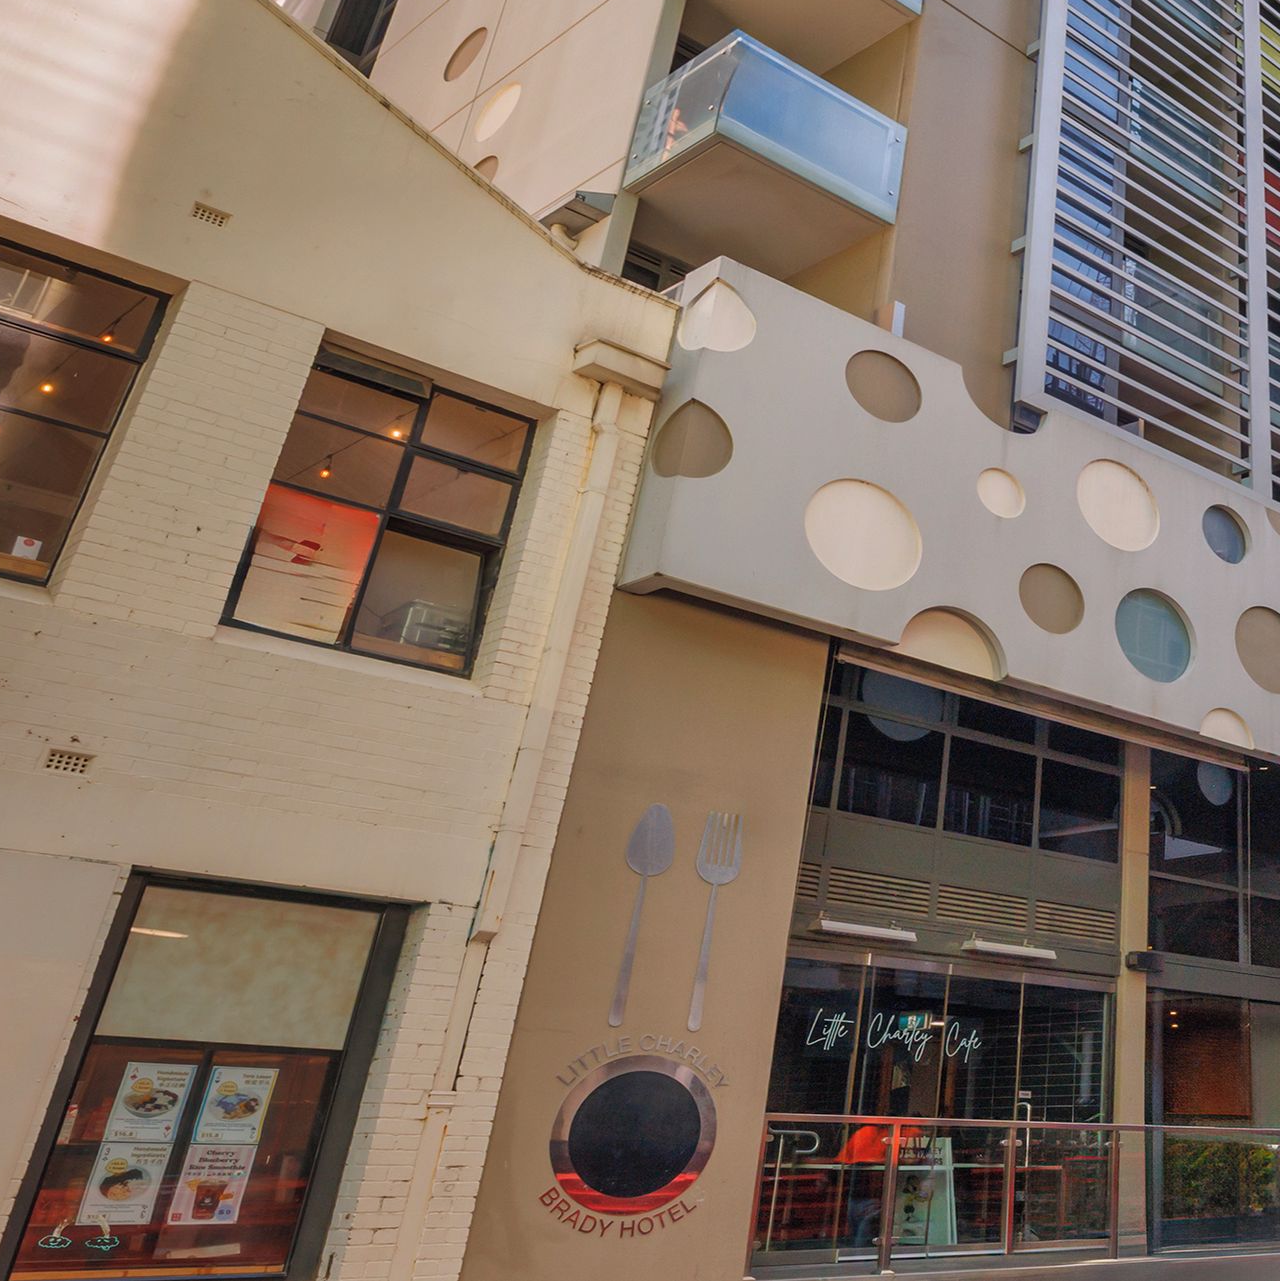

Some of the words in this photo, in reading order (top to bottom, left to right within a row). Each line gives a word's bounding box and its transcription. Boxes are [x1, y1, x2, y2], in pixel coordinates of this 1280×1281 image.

[556, 1036, 633, 1088] LITTLE
[639, 1033, 729, 1089] CHARLEY
[806, 1007, 855, 1051] Little
[867, 1012, 934, 1063] Charley
[945, 1021, 983, 1064] Cafe
[538, 1186, 615, 1238] BRADY
[619, 1199, 697, 1239] HOTEL
